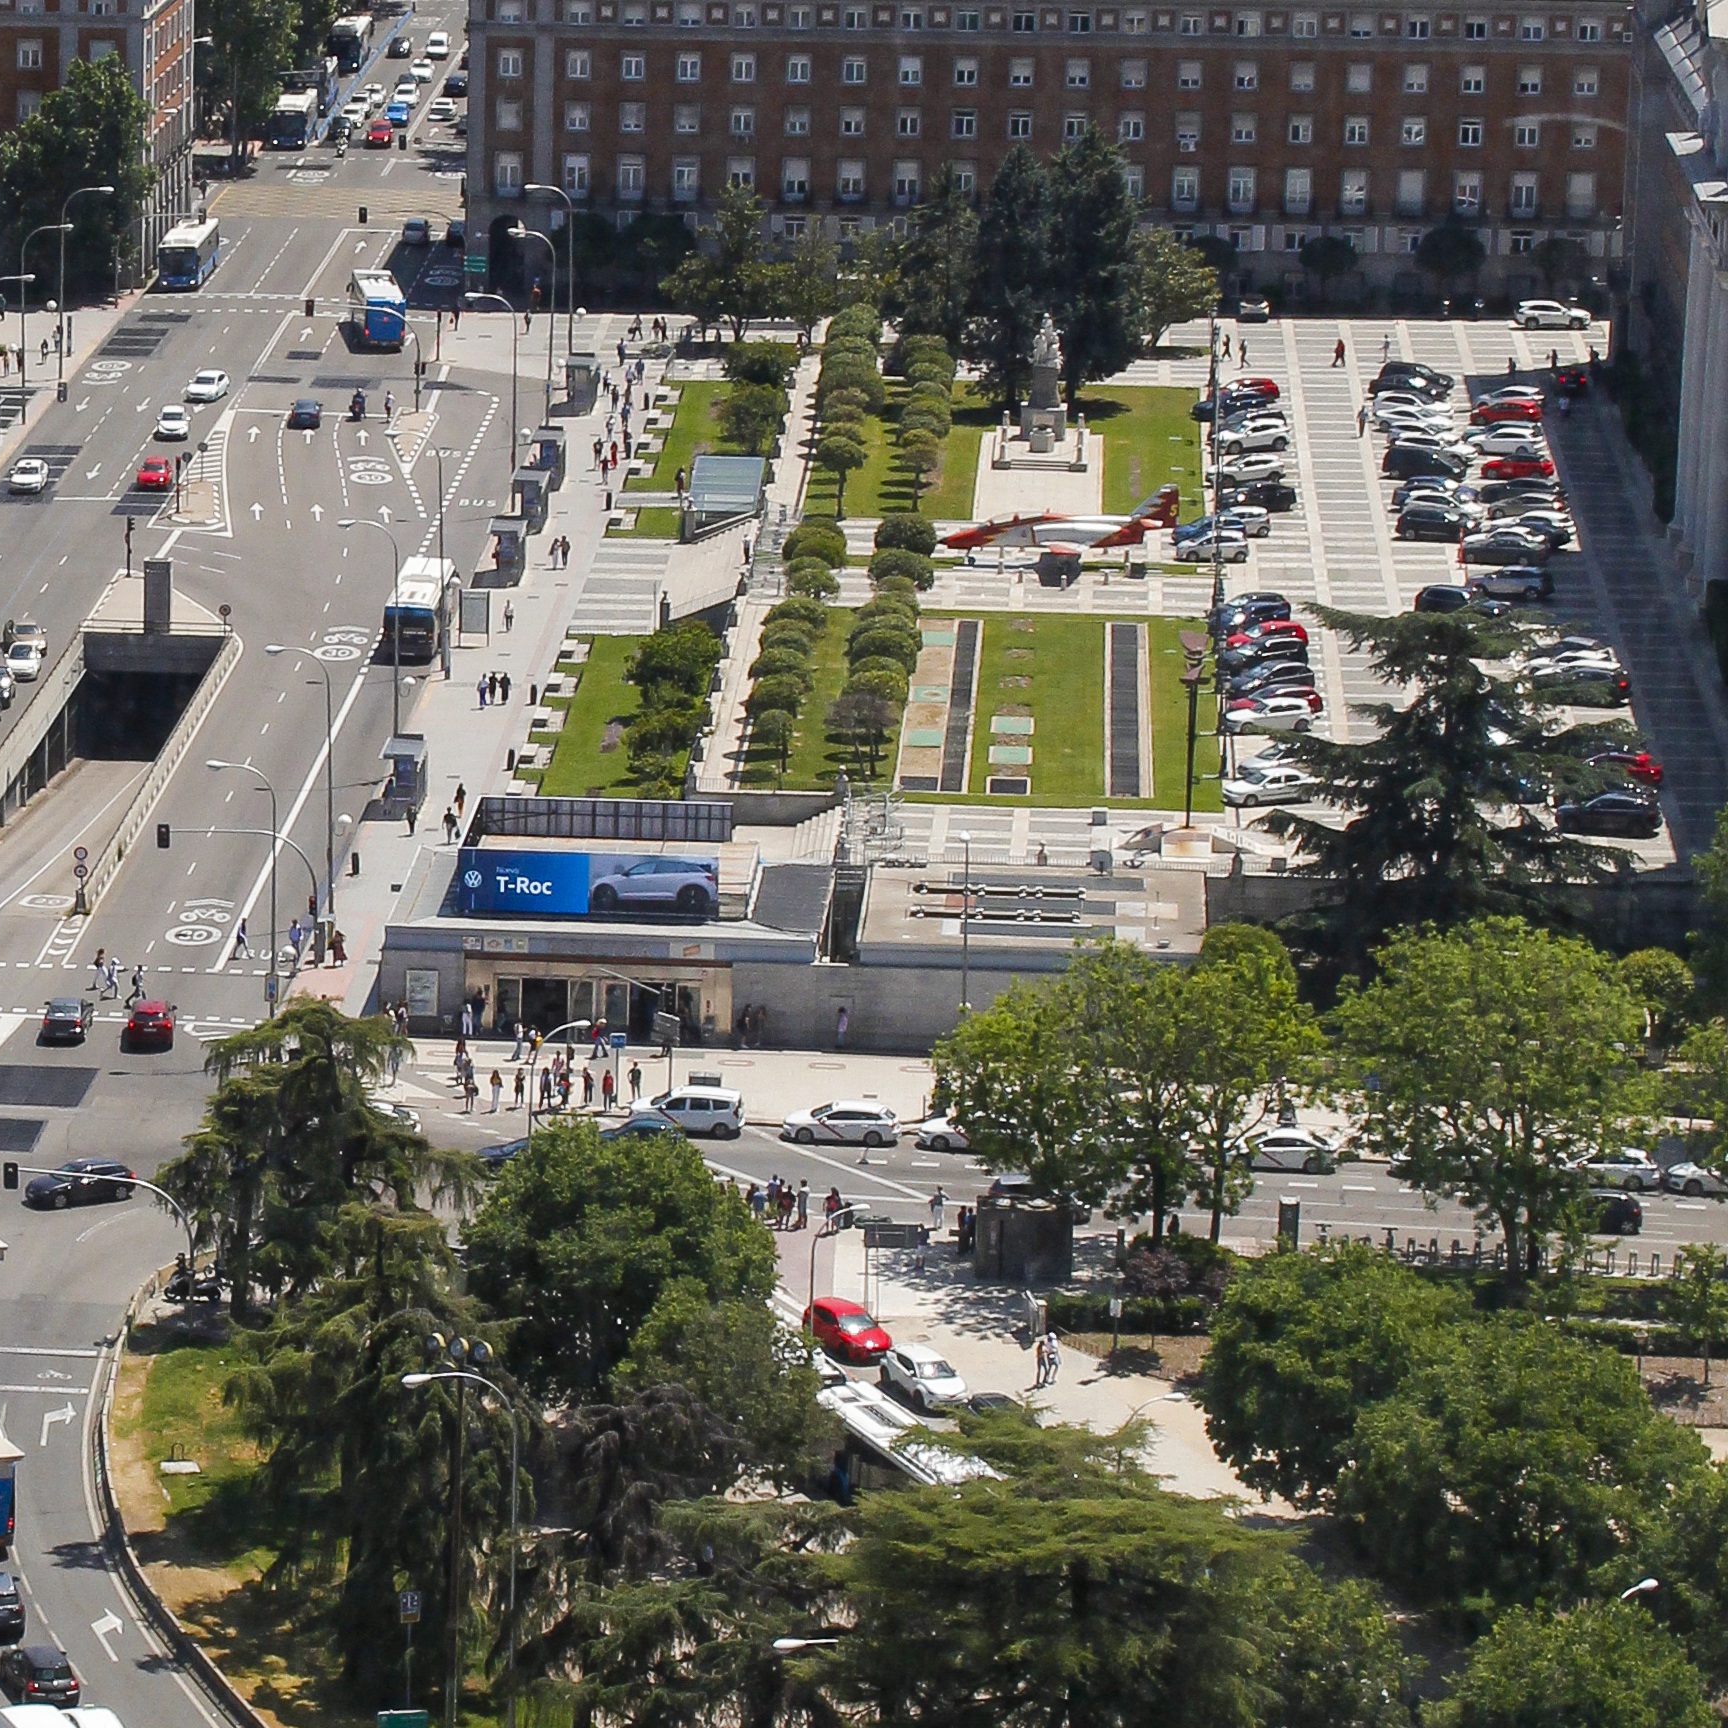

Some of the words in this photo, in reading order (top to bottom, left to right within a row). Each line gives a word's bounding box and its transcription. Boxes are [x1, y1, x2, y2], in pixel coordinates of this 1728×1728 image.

[425, 449, 462, 458] BUS
[458, 498, 497, 508] BUS
[1169, 504, 1179, 518] 5
[495, 875, 553, 896] T-Roc
